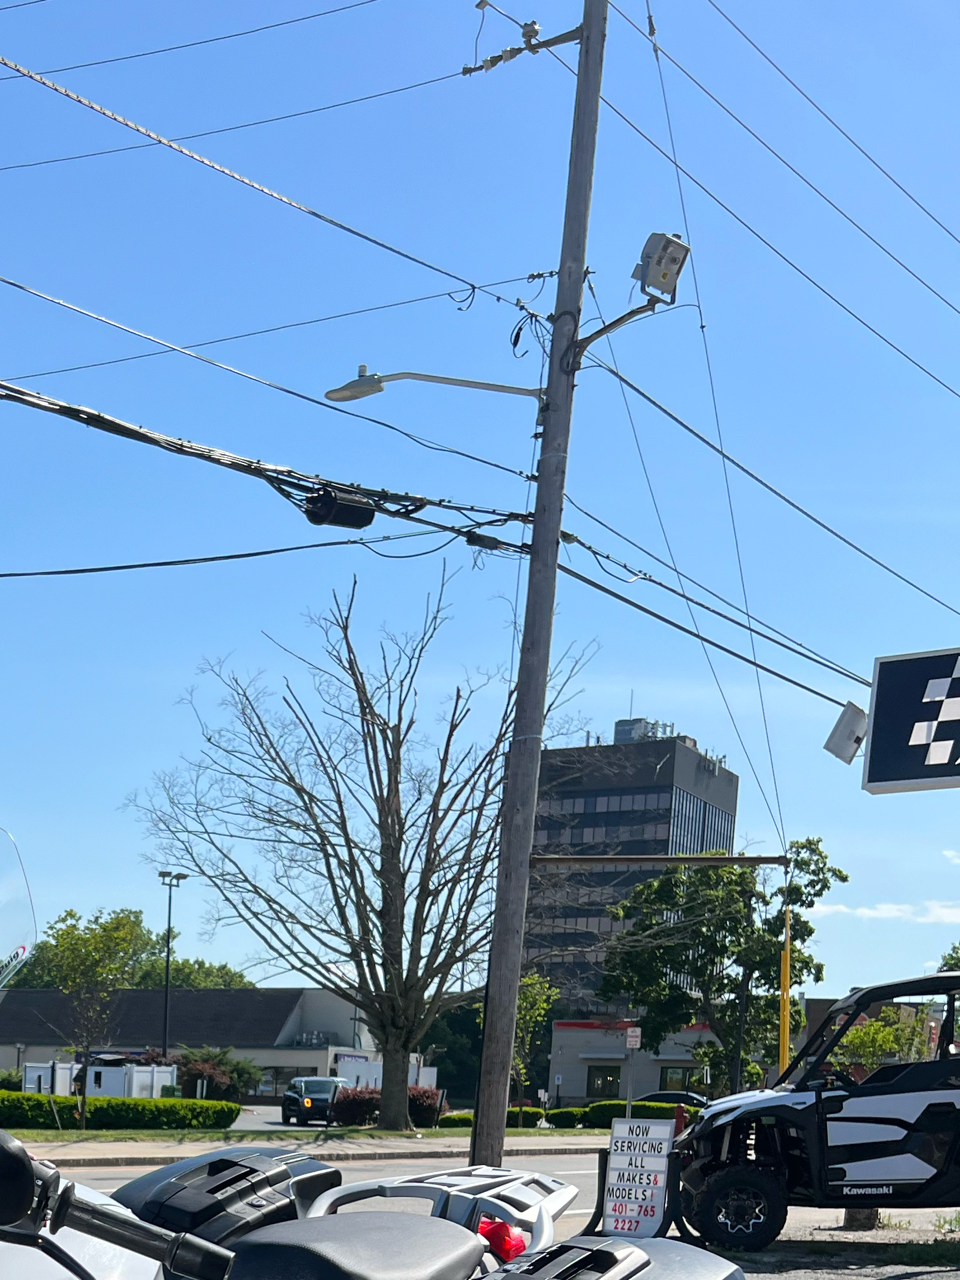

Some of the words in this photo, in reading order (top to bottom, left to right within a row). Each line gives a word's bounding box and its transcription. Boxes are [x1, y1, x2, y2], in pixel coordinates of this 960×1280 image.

[628, 1125, 650, 1137] NOW
[613, 1140, 663, 1154] SERVICING
[627, 1157, 645, 1169] ALL
[843, 1185, 893, 1195] Kawasaki
[613, 1218, 640, 1232] 2227
